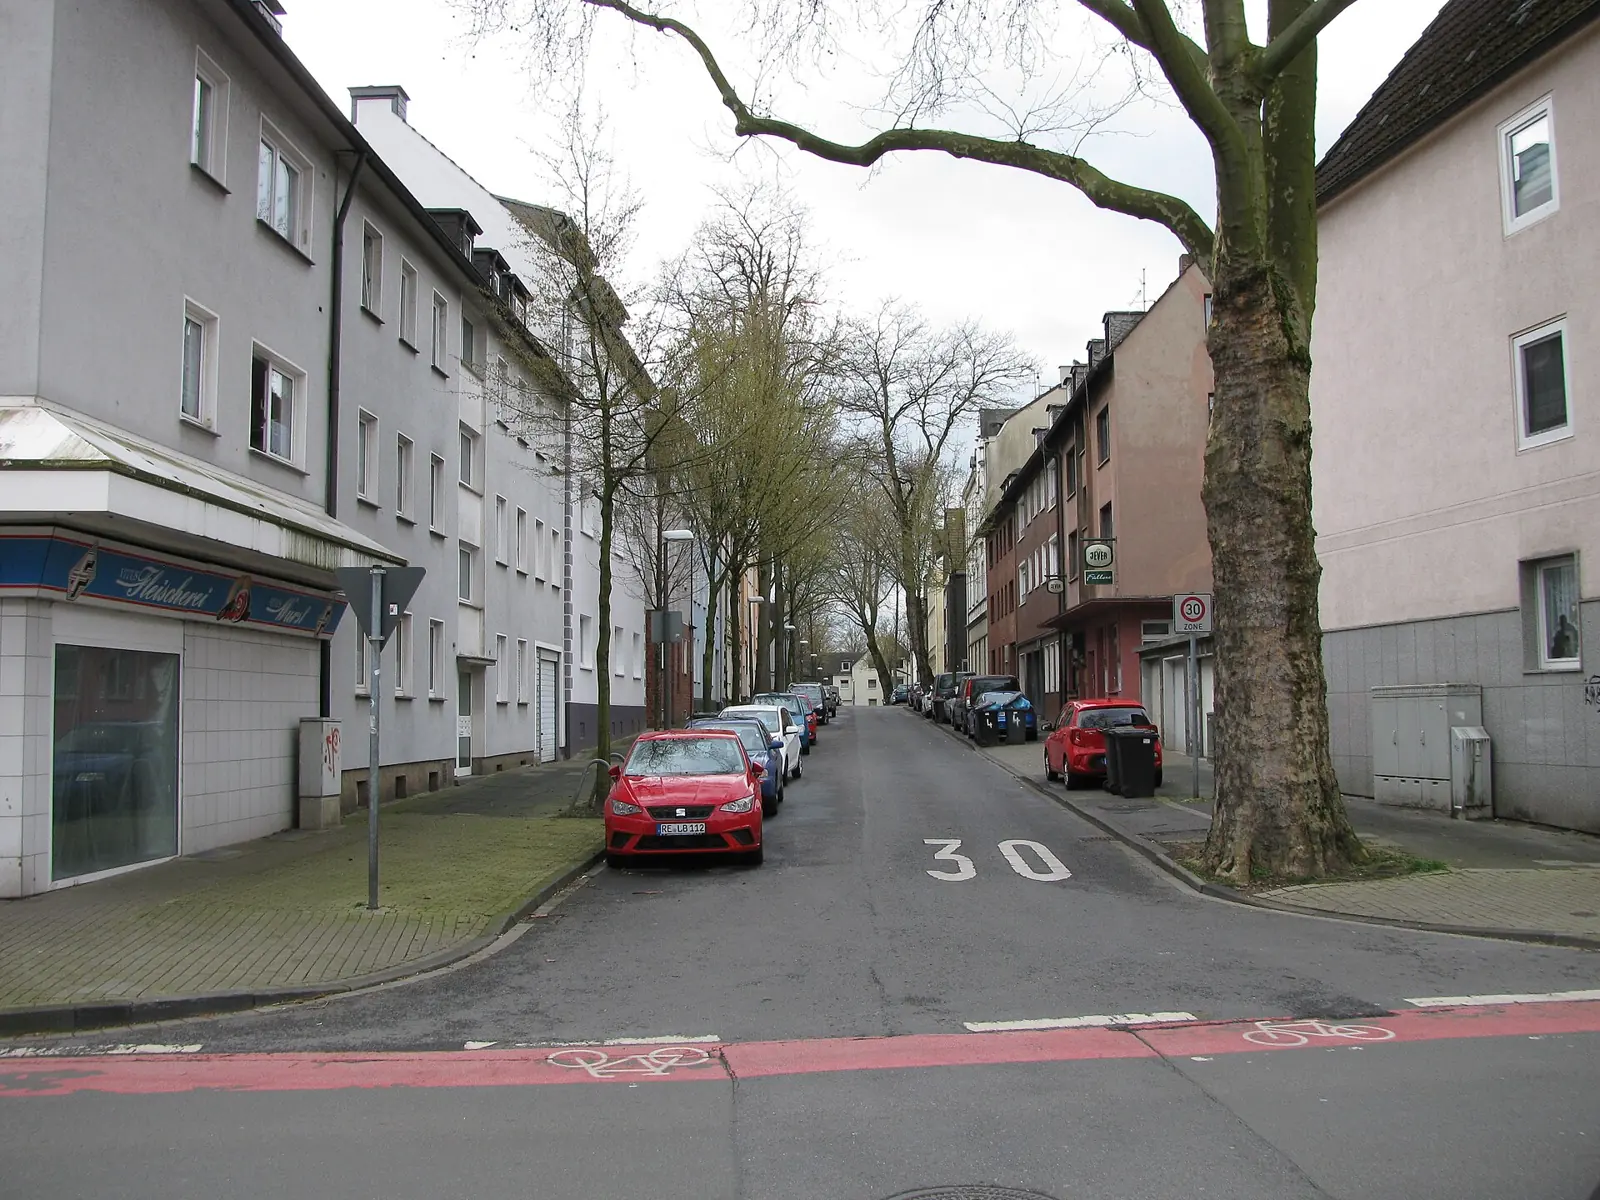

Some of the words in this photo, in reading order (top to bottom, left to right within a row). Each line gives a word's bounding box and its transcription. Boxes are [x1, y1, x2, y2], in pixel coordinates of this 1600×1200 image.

[1089, 550, 1108, 561] JEVER
[116, 566, 213, 608] Fleischerei
[1185, 603, 1201, 615] 30
[661, 824, 673, 833] RE
[689, 823, 705, 832] 112
